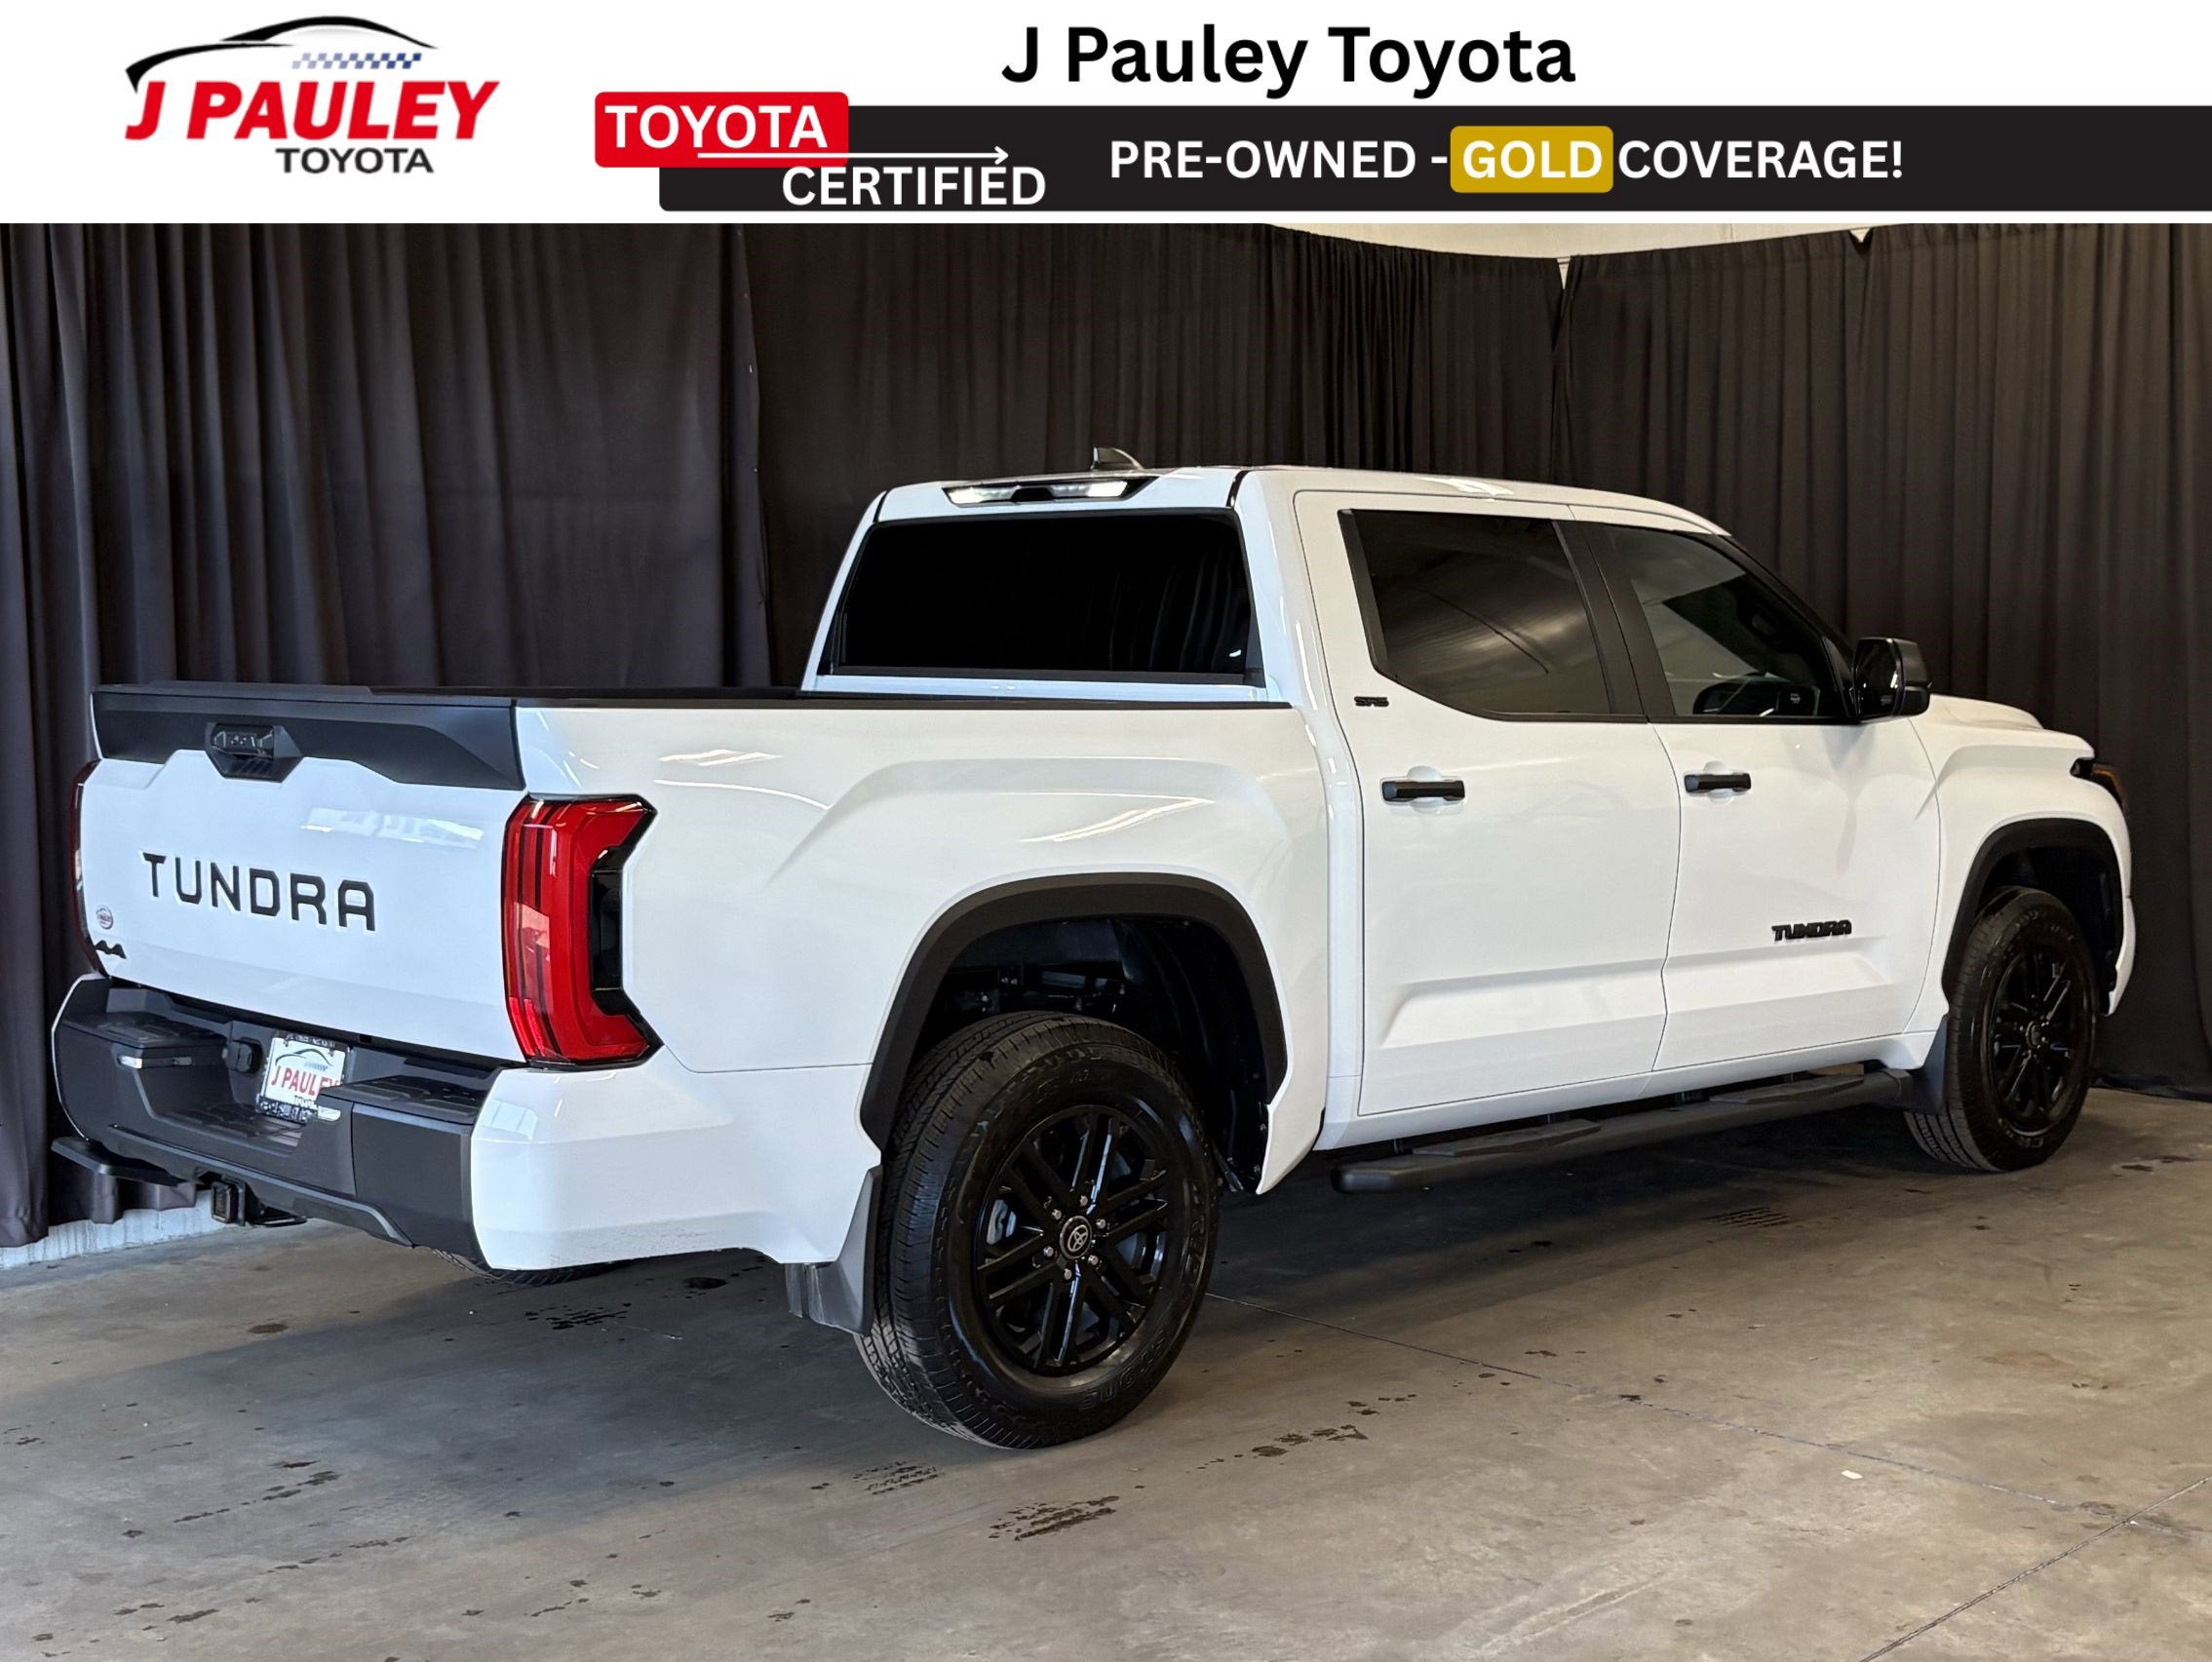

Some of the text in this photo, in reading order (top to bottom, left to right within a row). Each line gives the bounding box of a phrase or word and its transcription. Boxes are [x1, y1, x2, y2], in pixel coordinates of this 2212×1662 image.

[141, 851, 375, 932] TUNDRA
[1771, 919, 1852, 942] TUNDRA
[270, 1065, 281, 1086] J
